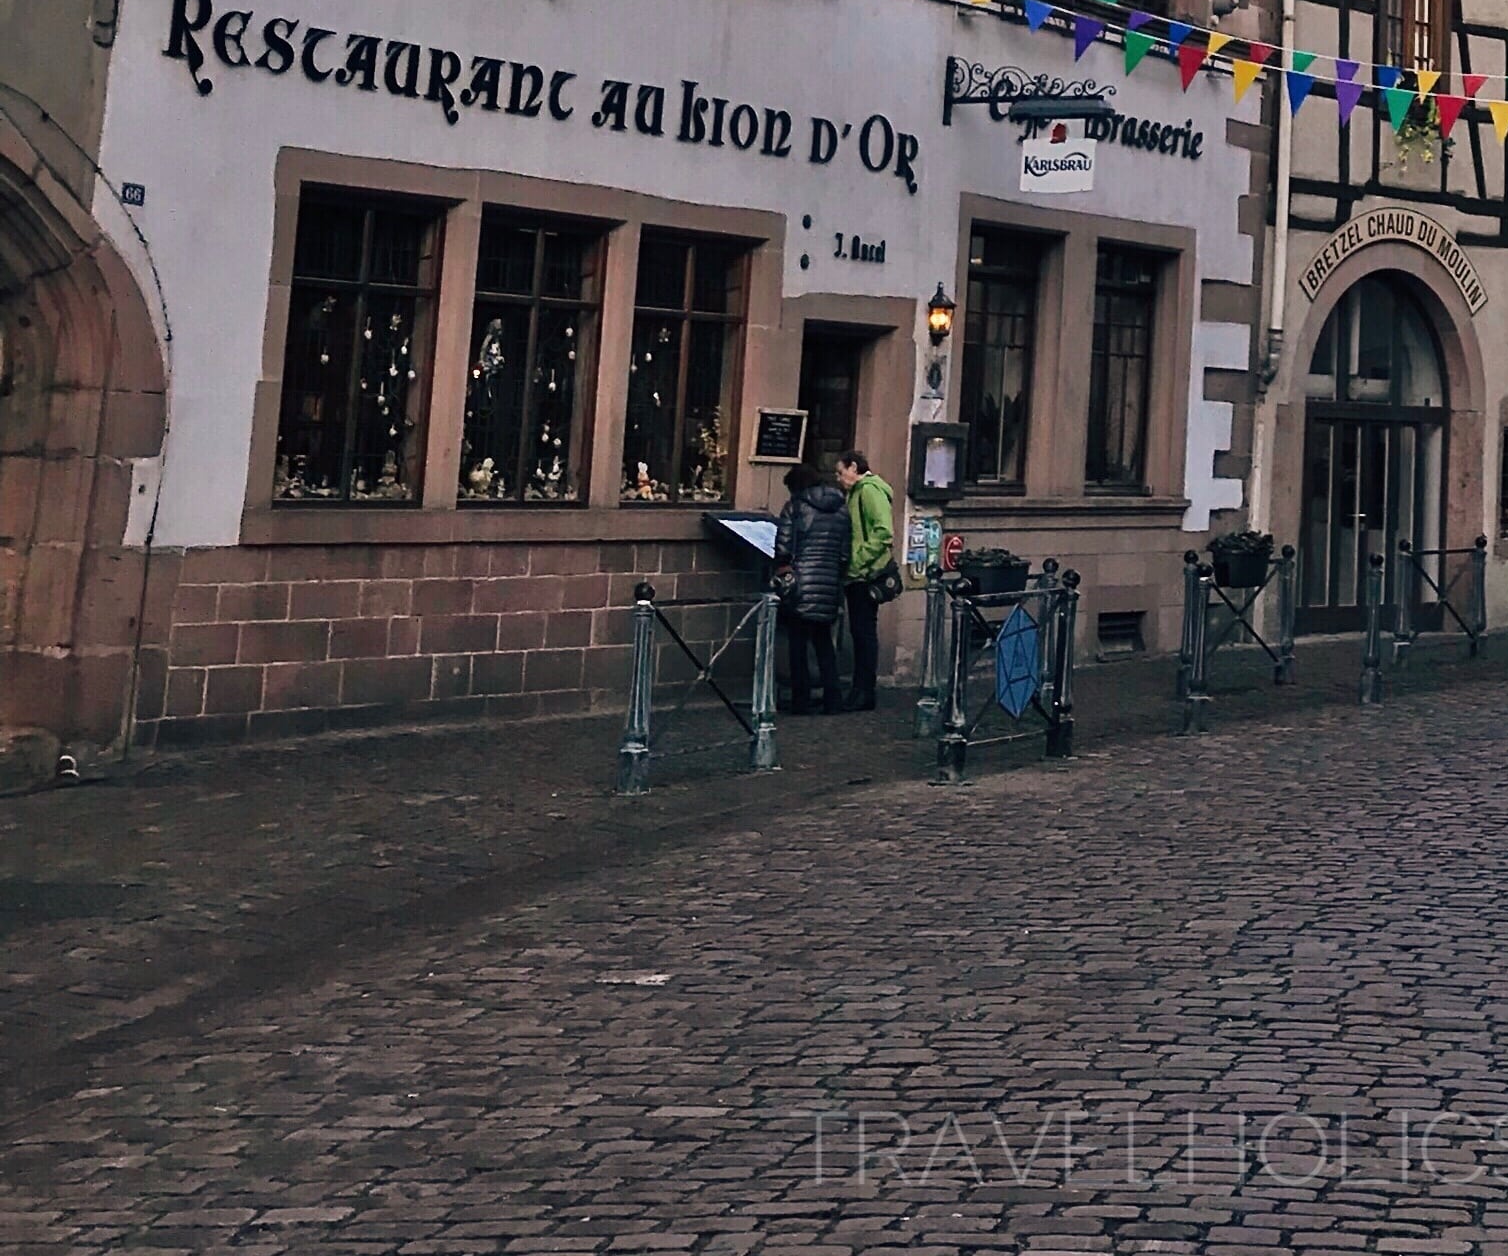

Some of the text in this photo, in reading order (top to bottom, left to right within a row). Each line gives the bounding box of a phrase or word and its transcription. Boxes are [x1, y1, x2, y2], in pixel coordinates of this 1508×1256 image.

[592, 80, 664, 136] AU
[676, 80, 792, 157] LION
[125, 187, 141, 201] 66
[1306, 213, 1482, 306] BRETZEL CHAUD DU MOULIN
